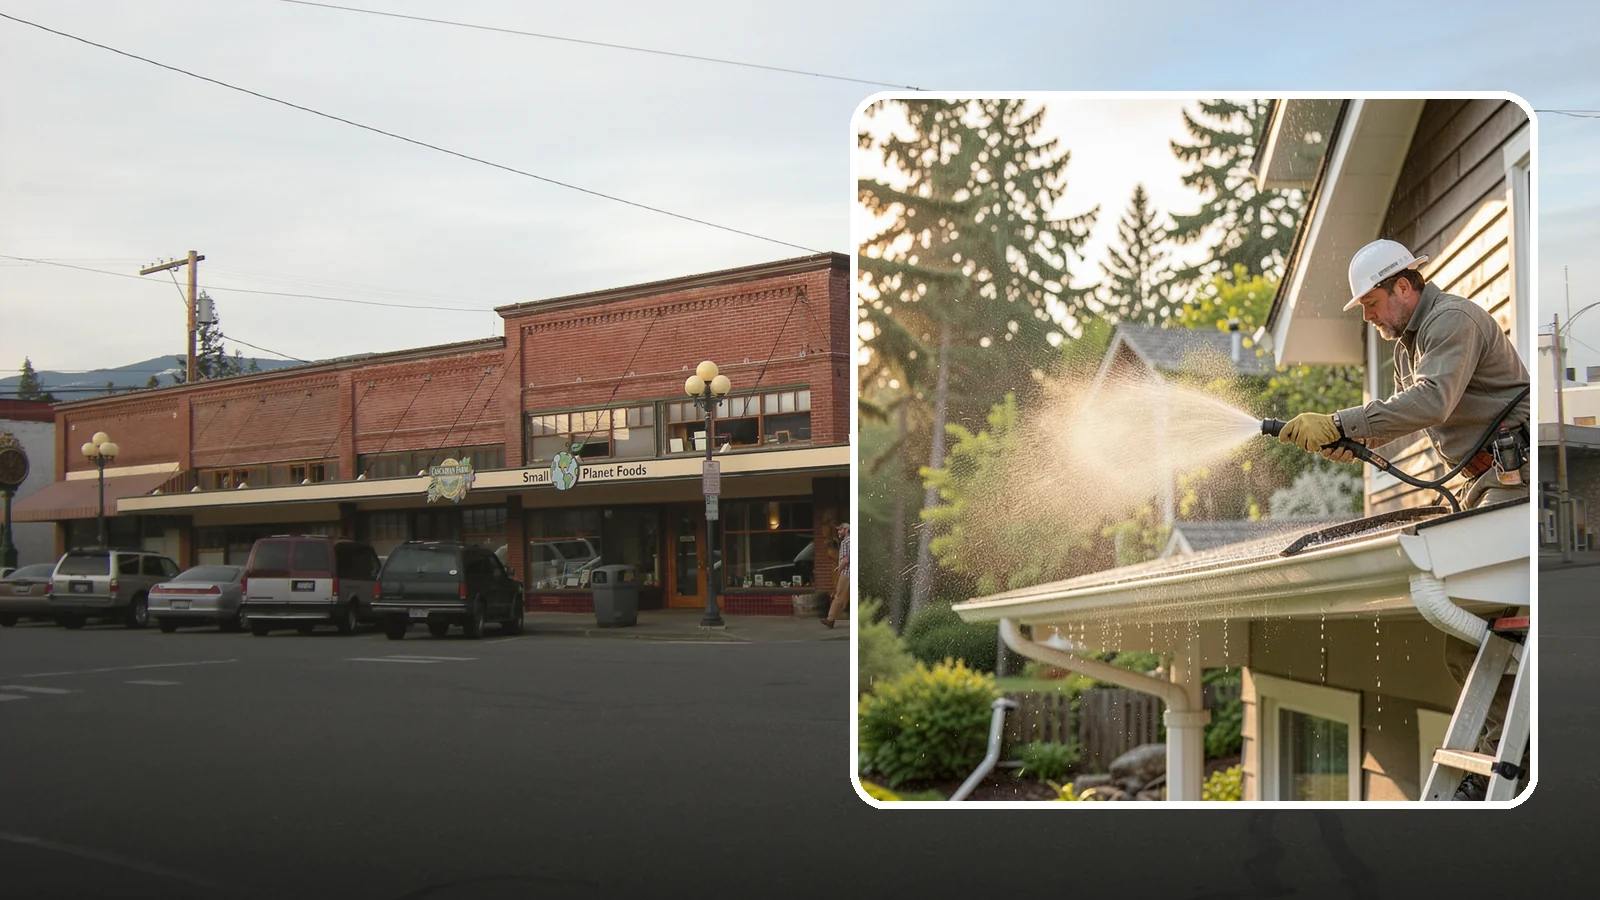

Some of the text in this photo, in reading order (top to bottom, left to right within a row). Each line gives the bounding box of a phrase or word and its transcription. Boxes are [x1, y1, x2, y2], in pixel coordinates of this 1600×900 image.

[523, 465, 647, 482] Small Planet Foods
